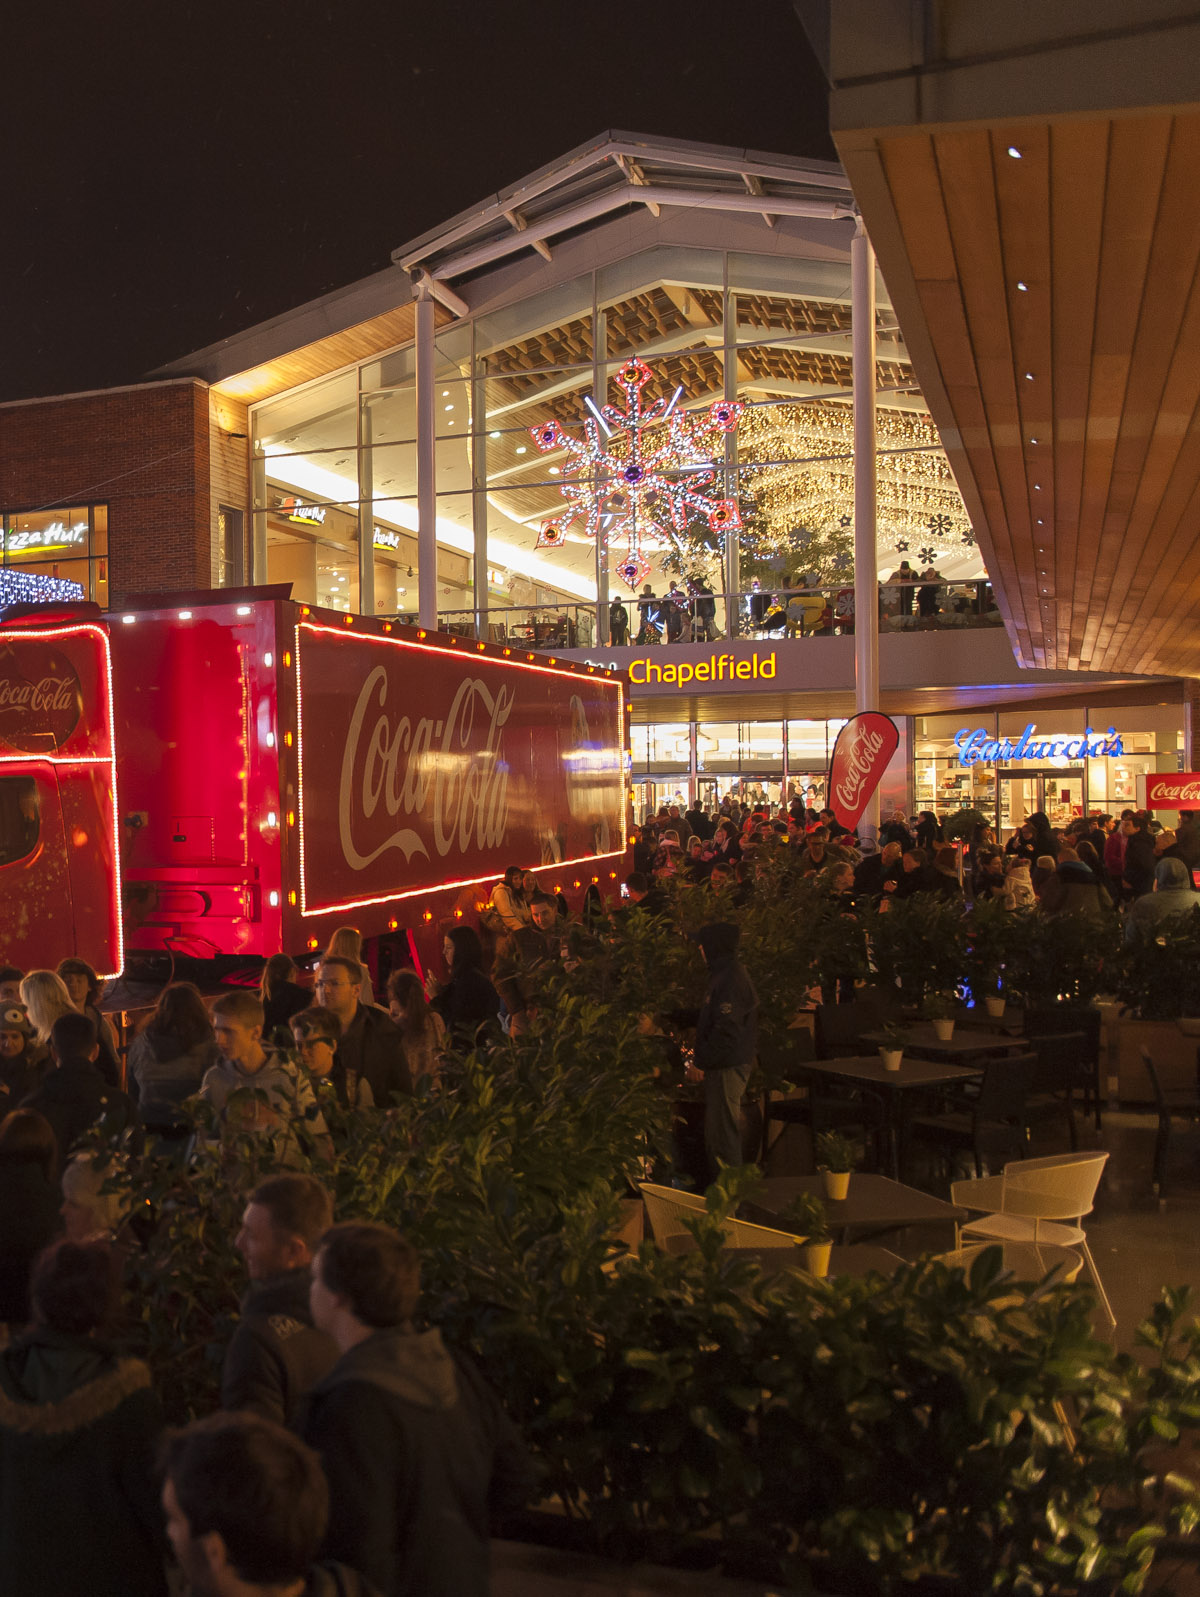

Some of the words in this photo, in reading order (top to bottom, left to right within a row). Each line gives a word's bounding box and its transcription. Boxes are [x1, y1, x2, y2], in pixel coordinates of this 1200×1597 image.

[629, 652, 776, 688] Chapelfield
[836, 723, 884, 811] Coca-Cola
[954, 723, 1127, 767] Carluccio's
[339, 665, 515, 871] Coca-Cola
[1150, 782, 1200, 801] Coca-Co
